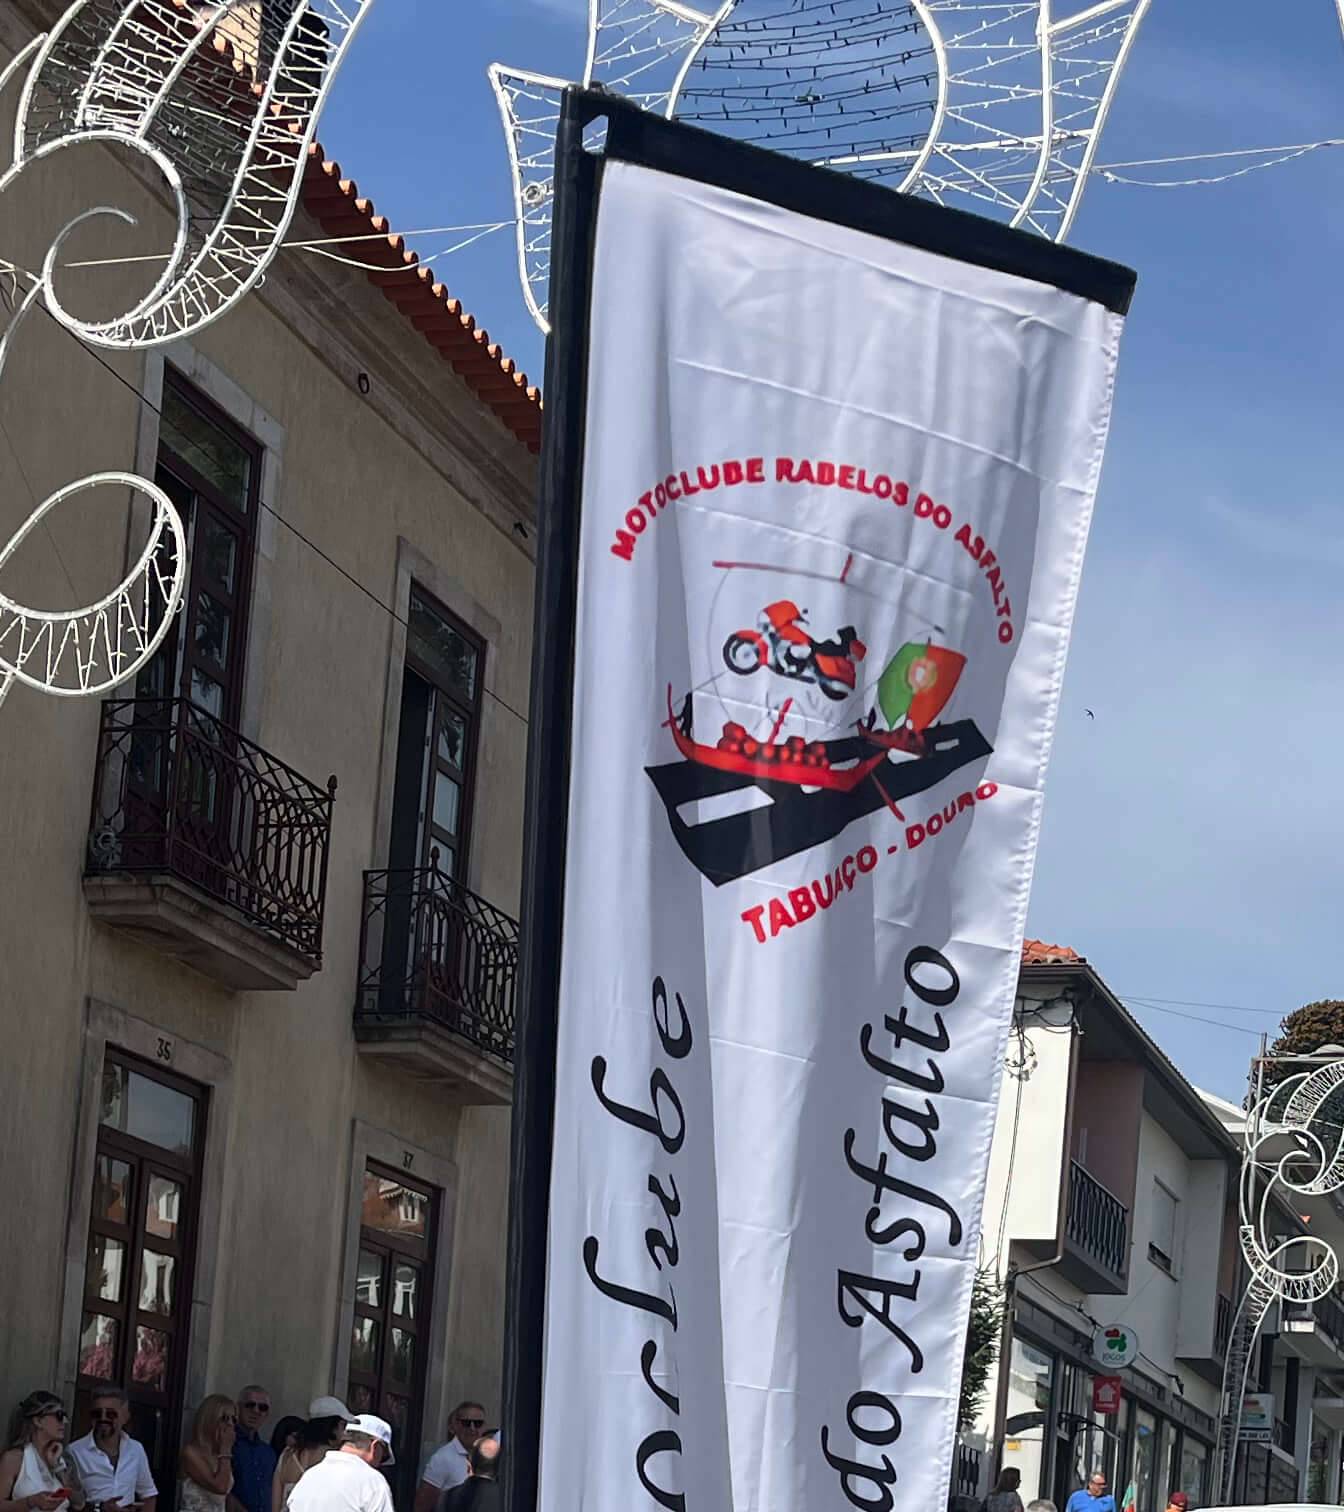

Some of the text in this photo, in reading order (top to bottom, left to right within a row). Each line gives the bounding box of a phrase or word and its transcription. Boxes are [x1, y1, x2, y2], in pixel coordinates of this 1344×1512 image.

[611, 456, 1014, 644] MOTOCLUBE RABELOS DO ASFALTO
[741, 844, 879, 945] TABUAÇO
[906, 781, 999, 850] DOURO
[157, 1037, 171, 1061] 35
[837, 944, 963, 1374] Asfalto
